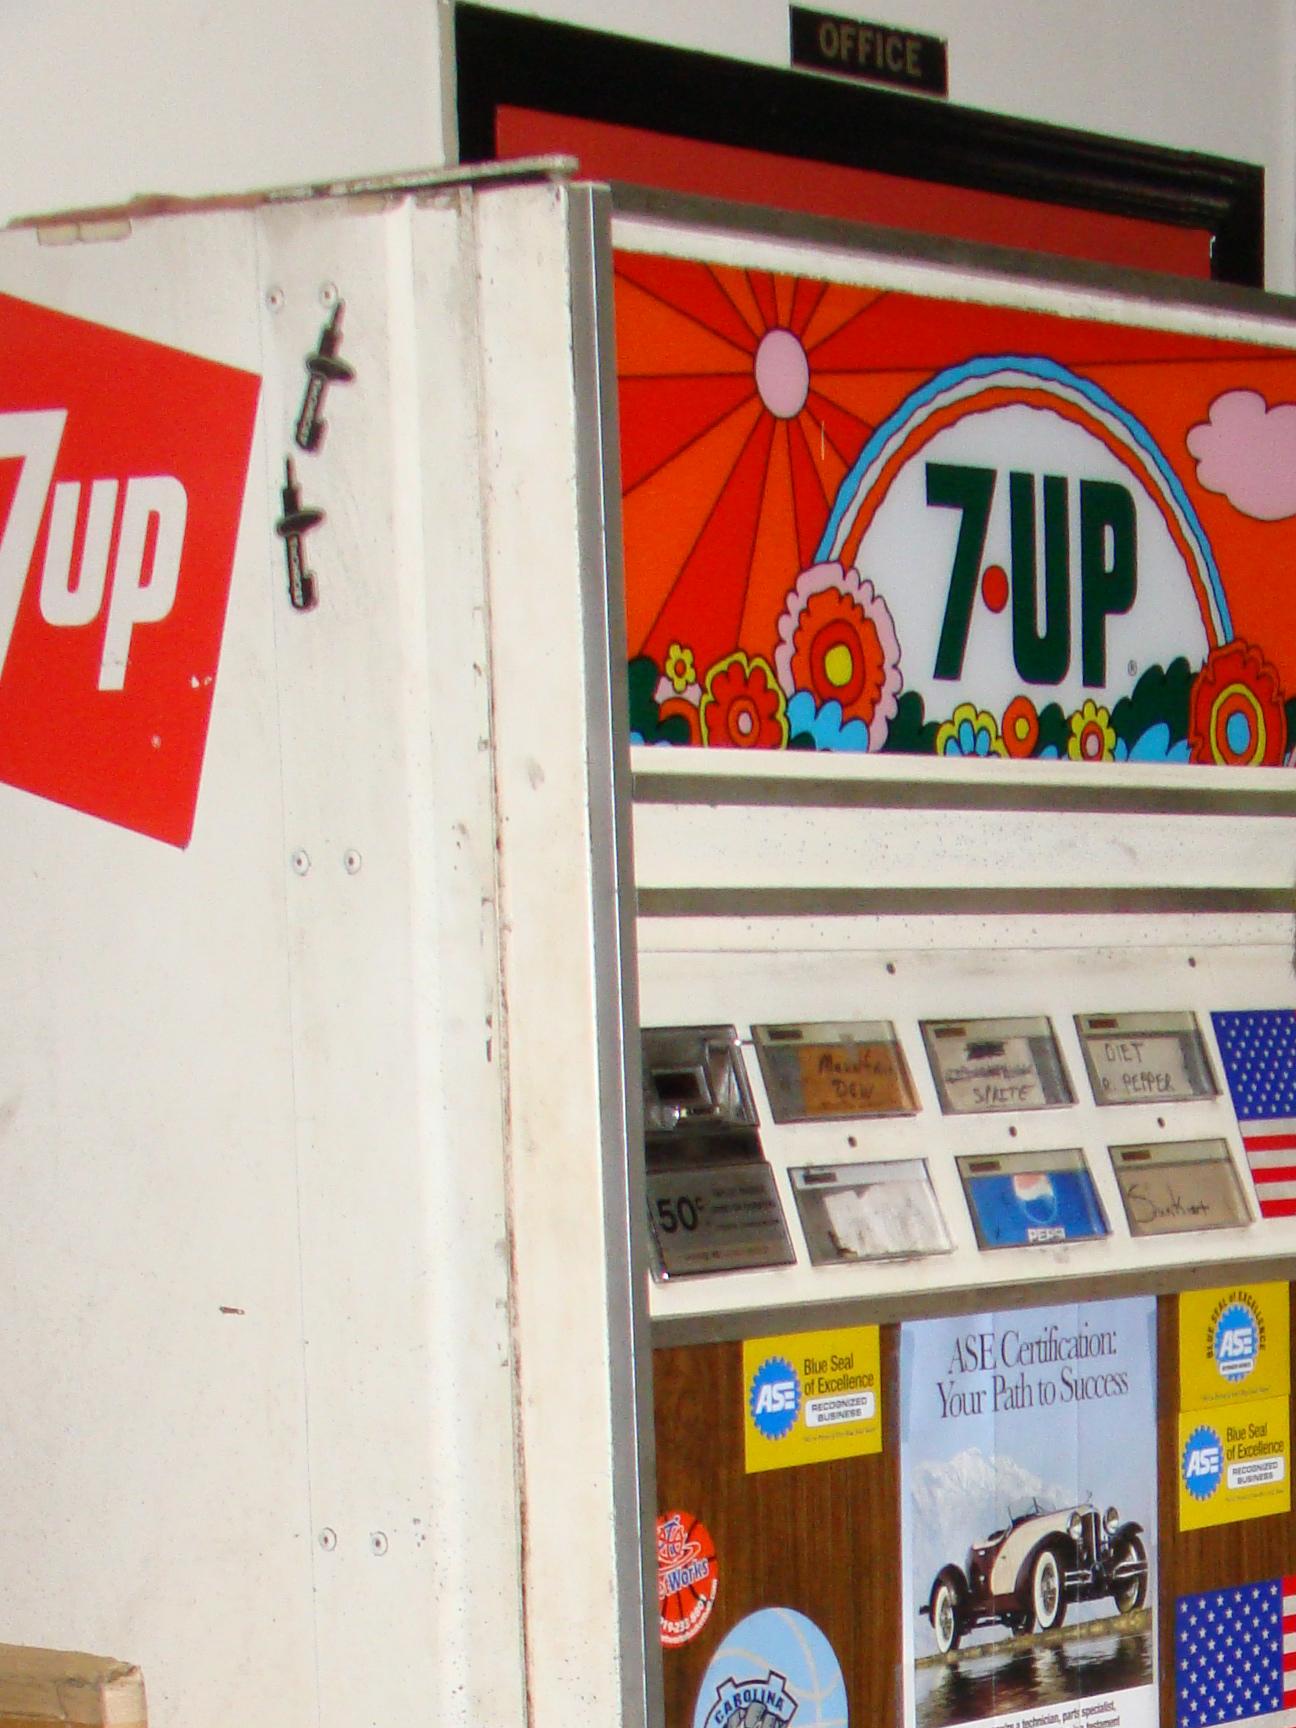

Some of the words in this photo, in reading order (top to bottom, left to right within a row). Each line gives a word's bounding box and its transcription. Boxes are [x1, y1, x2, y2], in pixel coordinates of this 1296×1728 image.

[819, 22, 922, 77] OFFICE
[1104, 1042, 1144, 1063] DIET
[948, 1331, 998, 1375] ASE
[1001, 1321, 1118, 1370] Certification:
[1219, 1327, 1253, 1358] ASE
[804, 1357, 828, 1376] Blue
[830, 1352, 854, 1372] Seal
[804, 1379, 815, 1396] of
[817, 1373, 875, 1394] Excellence
[936, 1380, 987, 1419] Your
[991, 1371, 1034, 1413] Path
[1038, 1376, 1057, 1406] to
[1060, 1365, 1130, 1403] Success
[756, 1381, 796, 1415] ASE
[811, 1396, 868, 1412] RECOGNIZED
[817, 1408, 862, 1422] BUSINESS
[1226, 1426, 1247, 1442] Blue
[1248, 1423, 1268, 1439] Seal
[1226, 1446, 1236, 1460] of
[1237, 1440, 1285, 1459] Excellence
[1186, 1447, 1219, 1478] ASE
[714, 1688, 784, 1724] CAROLINA
[1062, 1708, 1080, 1723] parts
